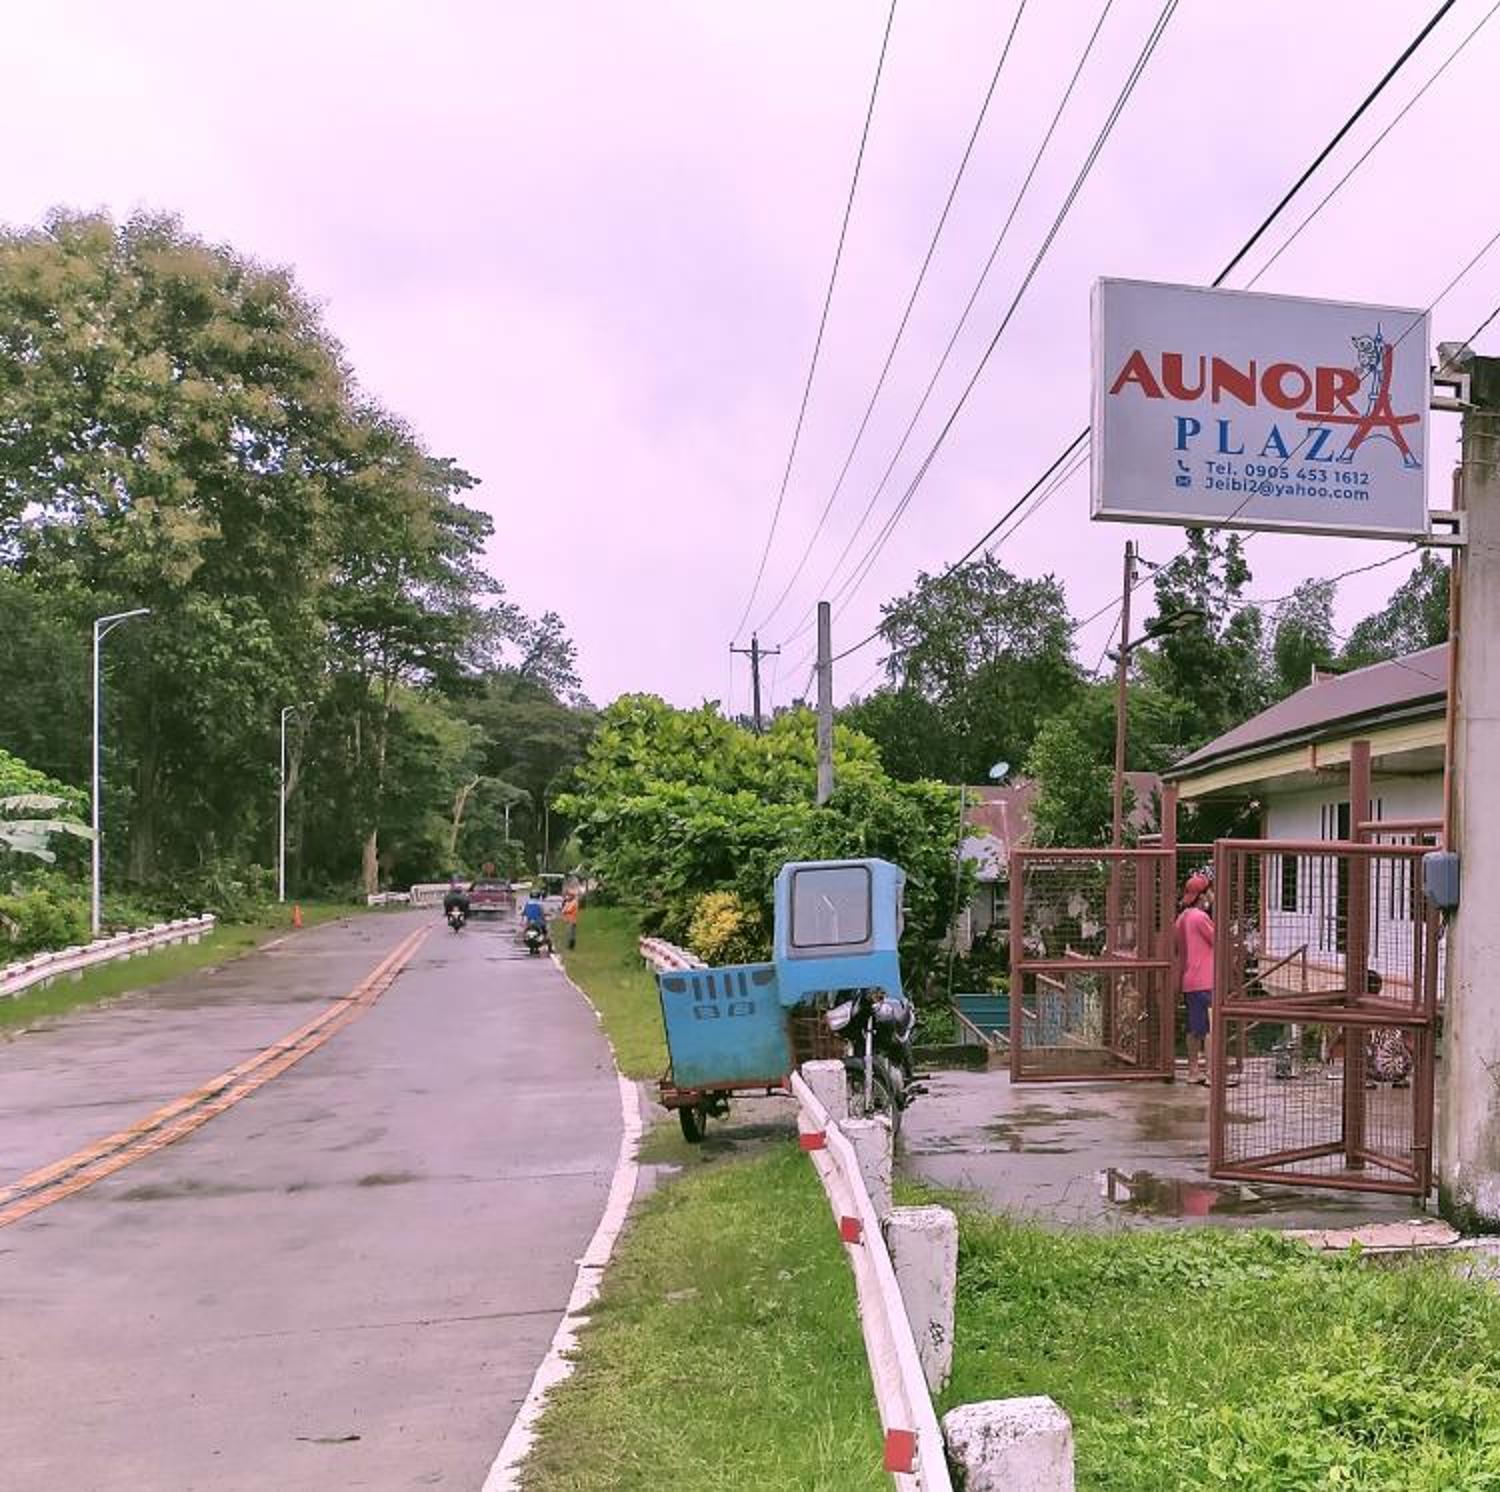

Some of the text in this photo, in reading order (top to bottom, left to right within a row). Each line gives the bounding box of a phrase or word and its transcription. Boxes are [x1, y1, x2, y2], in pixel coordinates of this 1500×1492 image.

[1206, 461, 1370, 486] Tel. 0905 453 1612
[1204, 477, 1370, 501] Jeibi2@yahoo.com
